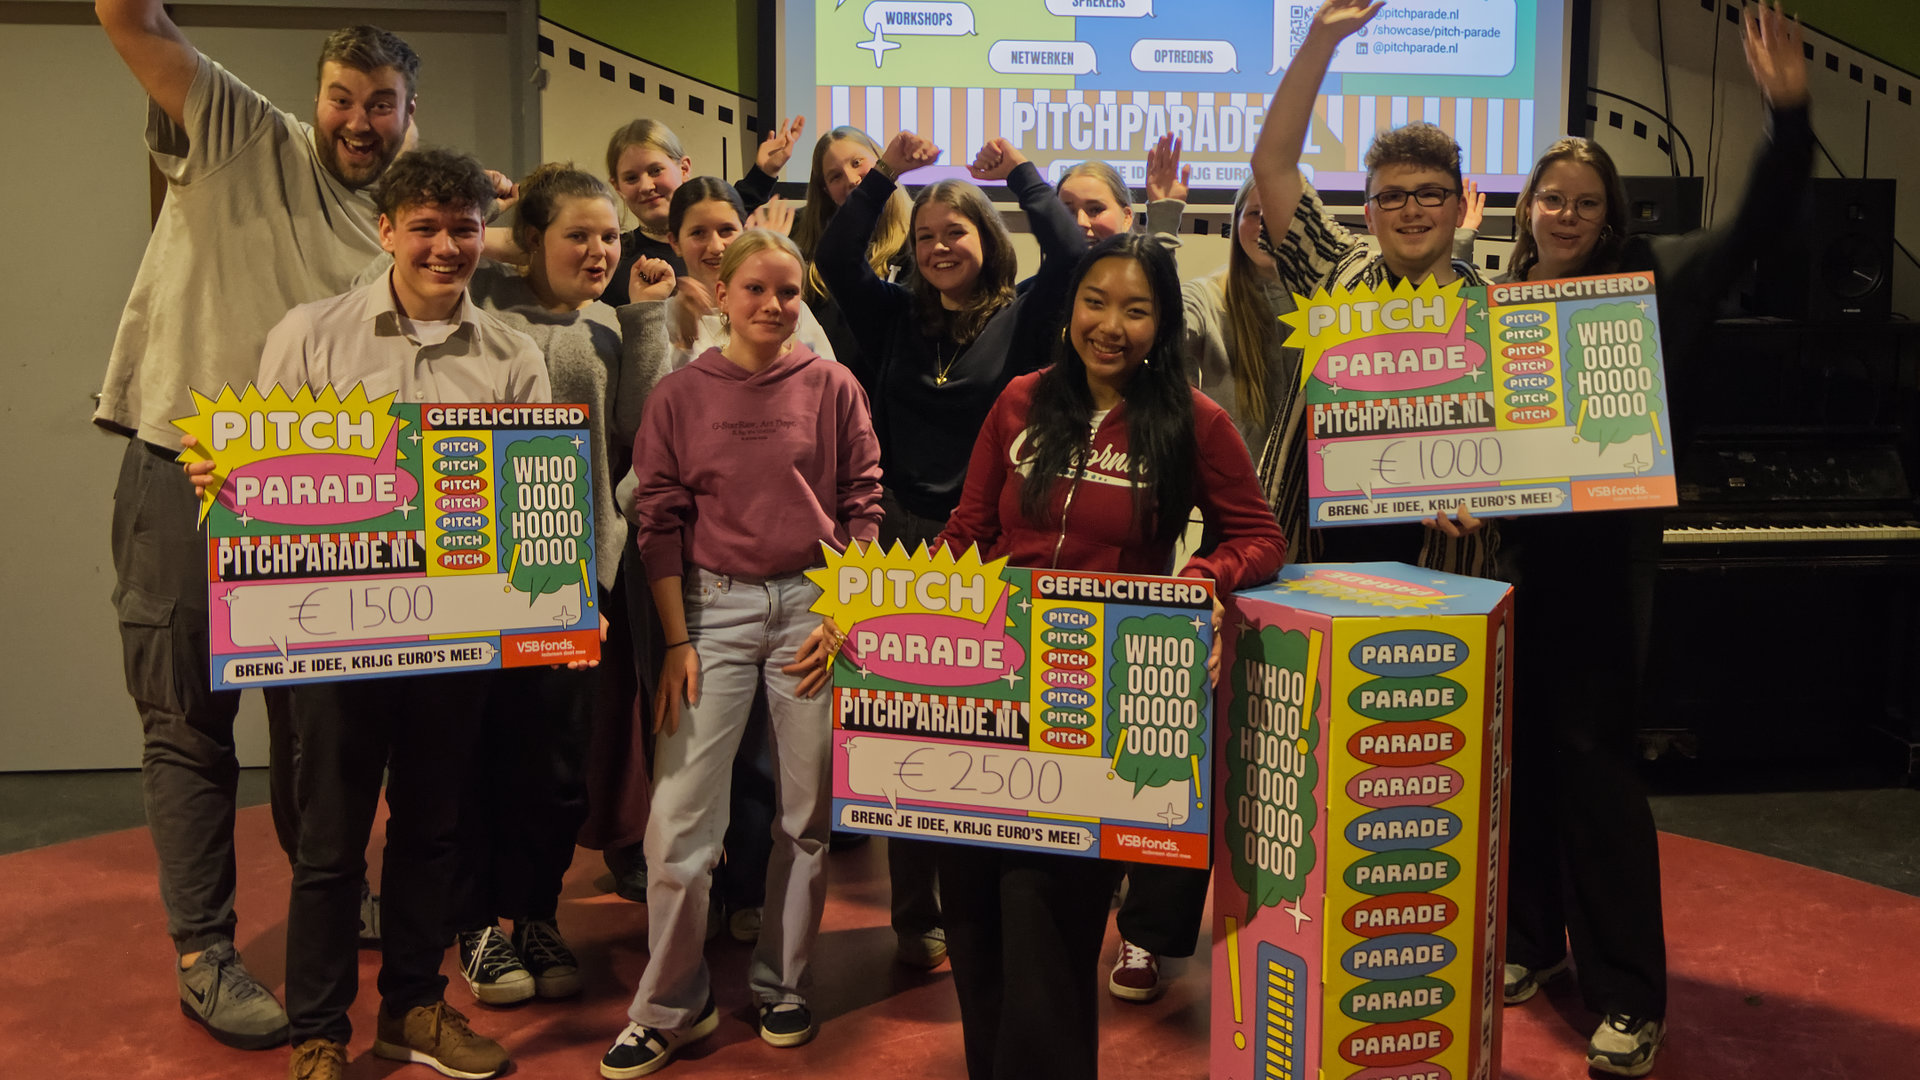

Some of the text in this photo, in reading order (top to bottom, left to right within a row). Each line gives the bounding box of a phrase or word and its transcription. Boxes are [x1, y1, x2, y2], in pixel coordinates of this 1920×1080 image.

[886, 11, 953, 26] WORKSHOPS
[1376, 9, 1459, 20] @pitchparade.nl
[1373, 25, 1501, 38] /showcase/pitch-parade
[1011, 50, 1074, 65] NETWERKEN
[1154, 49, 1214, 64] OPTREDENS
[1373, 43, 1459, 54] @pitchparade.nl
[1013, 102, 1321, 154] PITCHPARADEL
[1493, 277, 1649, 303] GEFELICITEERD
[1308, 295, 1446, 337] PITCH
[1505, 312, 1543, 324] PITCH
[1505, 328, 1543, 340] PITCH
[1577, 319, 1644, 347] WHOO
[1507, 345, 1546, 356] PITCH
[1328, 346, 1466, 378] PARADE
[1508, 360, 1547, 372] PITCH
[1509, 376, 1548, 388] PITCH
[1510, 392, 1549, 404] PITCH
[427, 407, 585, 427] GEFELICITEERD
[1313, 400, 1489, 434] PITCHPARADE.NL
[1511, 408, 1551, 420] PITCH
[212, 411, 375, 451] PITCH
[439, 441, 480, 453] PITCH
[439, 459, 480, 472] PITCH
[513, 456, 577, 483] WHOO
[236, 474, 397, 506] PARADE
[441, 479, 481, 491] PITCH
[441, 497, 482, 509] PITCH
[1328, 503, 1368, 517] BRENG
[1373, 501, 1389, 514] JE
[1393, 499, 1424, 513] IDEE,
[1471, 495, 1516, 508] EURO'S
[1521, 492, 1552, 505] MEE!
[442, 516, 483, 528] PITCH
[443, 534, 483, 547] PITCH
[218, 538, 420, 576] PITCHPARADE.NL
[443, 553, 484, 565] PITCH
[838, 566, 985, 614] PITCH
[1037, 575, 1208, 603] GEFELICITEERD
[1048, 611, 1089, 626] PITCH
[1046, 631, 1088, 646] PITCH
[857, 631, 1004, 669] PARADE
[1047, 651, 1089, 666] PITCH
[1124, 634, 1195, 668] WHOO
[1362, 643, 1456, 664] PARADE
[235, 648, 482, 679] BRENG JE IDEE, KRIJG EURO'S MEE!
[1046, 671, 1088, 686] PITCH
[1245, 658, 1304, 706] WHOO
[1046, 690, 1088, 705] PITCH
[1360, 687, 1455, 709] PARADE
[840, 699, 1024, 739] PITCHPARADE.NL
[1046, 710, 1088, 725] PITCH
[1046, 730, 1088, 745] PITCH
[1359, 732, 1453, 754] PARADE
[1358, 775, 1452, 797] PARADE
[851, 810, 1081, 845] BRENG JE IDEE, KRIJG EURO'S MEE!
[1357, 817, 1450, 841] PARADE
[1356, 861, 1448, 885] PARADE
[1354, 903, 1446, 928] PARADE
[1353, 944, 1445, 969] PARADE
[1352, 987, 1443, 1013] PARADE
[1351, 1030, 1442, 1056] PARADE
